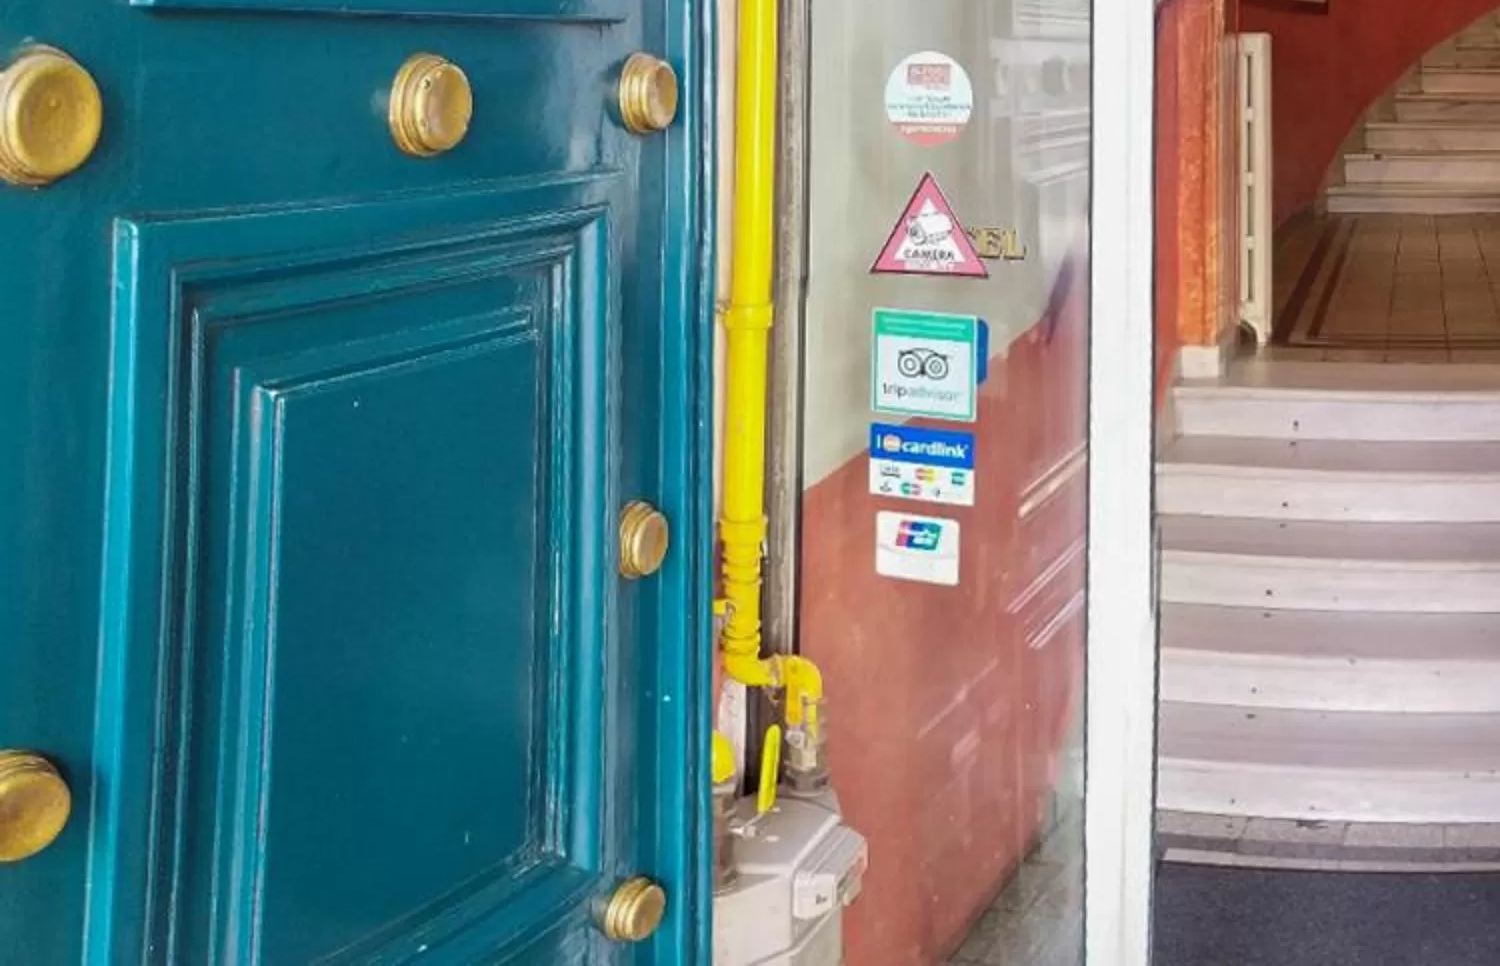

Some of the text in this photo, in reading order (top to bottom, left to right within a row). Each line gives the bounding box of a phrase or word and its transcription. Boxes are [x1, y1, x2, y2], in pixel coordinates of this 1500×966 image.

[966, 225, 1028, 261] EL
[902, 247, 955, 261] CAMERA
[901, 439, 966, 459] cardlink
